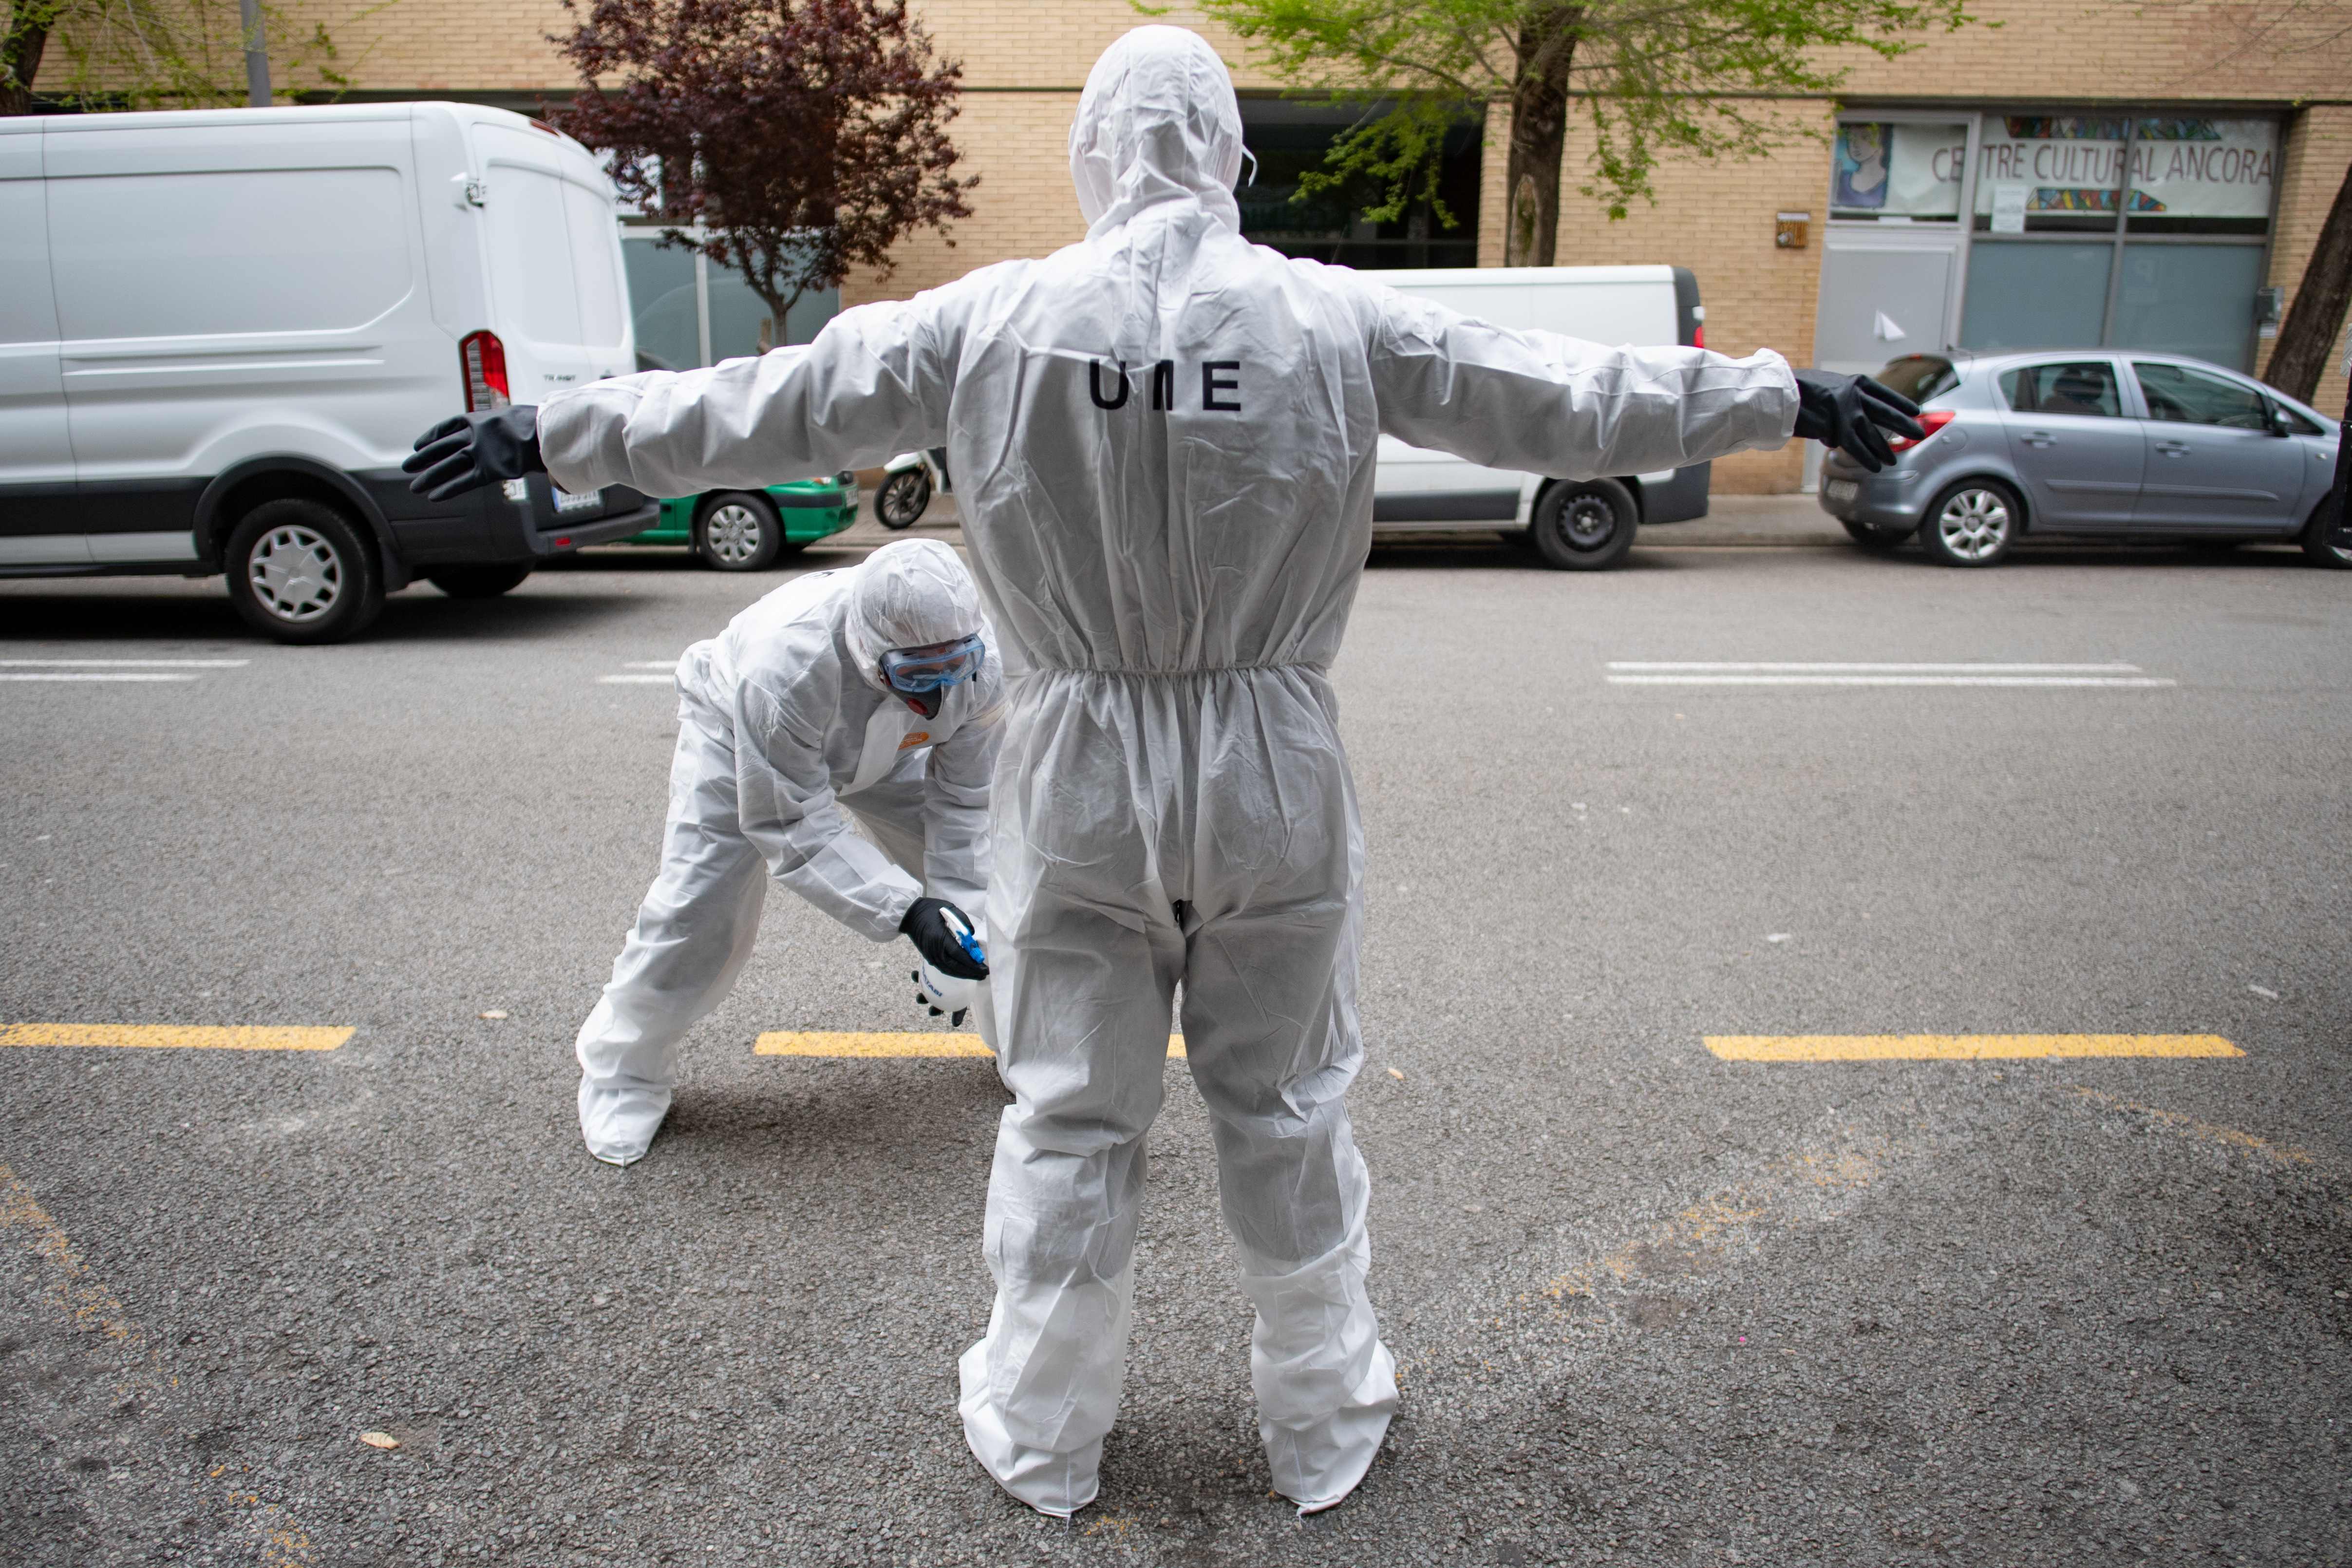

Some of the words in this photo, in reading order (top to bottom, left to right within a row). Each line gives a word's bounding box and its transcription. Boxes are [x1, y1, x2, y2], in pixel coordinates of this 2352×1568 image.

[1932, 143, 2027, 183] CETRE
[2033, 143, 2155, 183] CULTURAL
[2165, 145, 2273, 185] ANCORA
